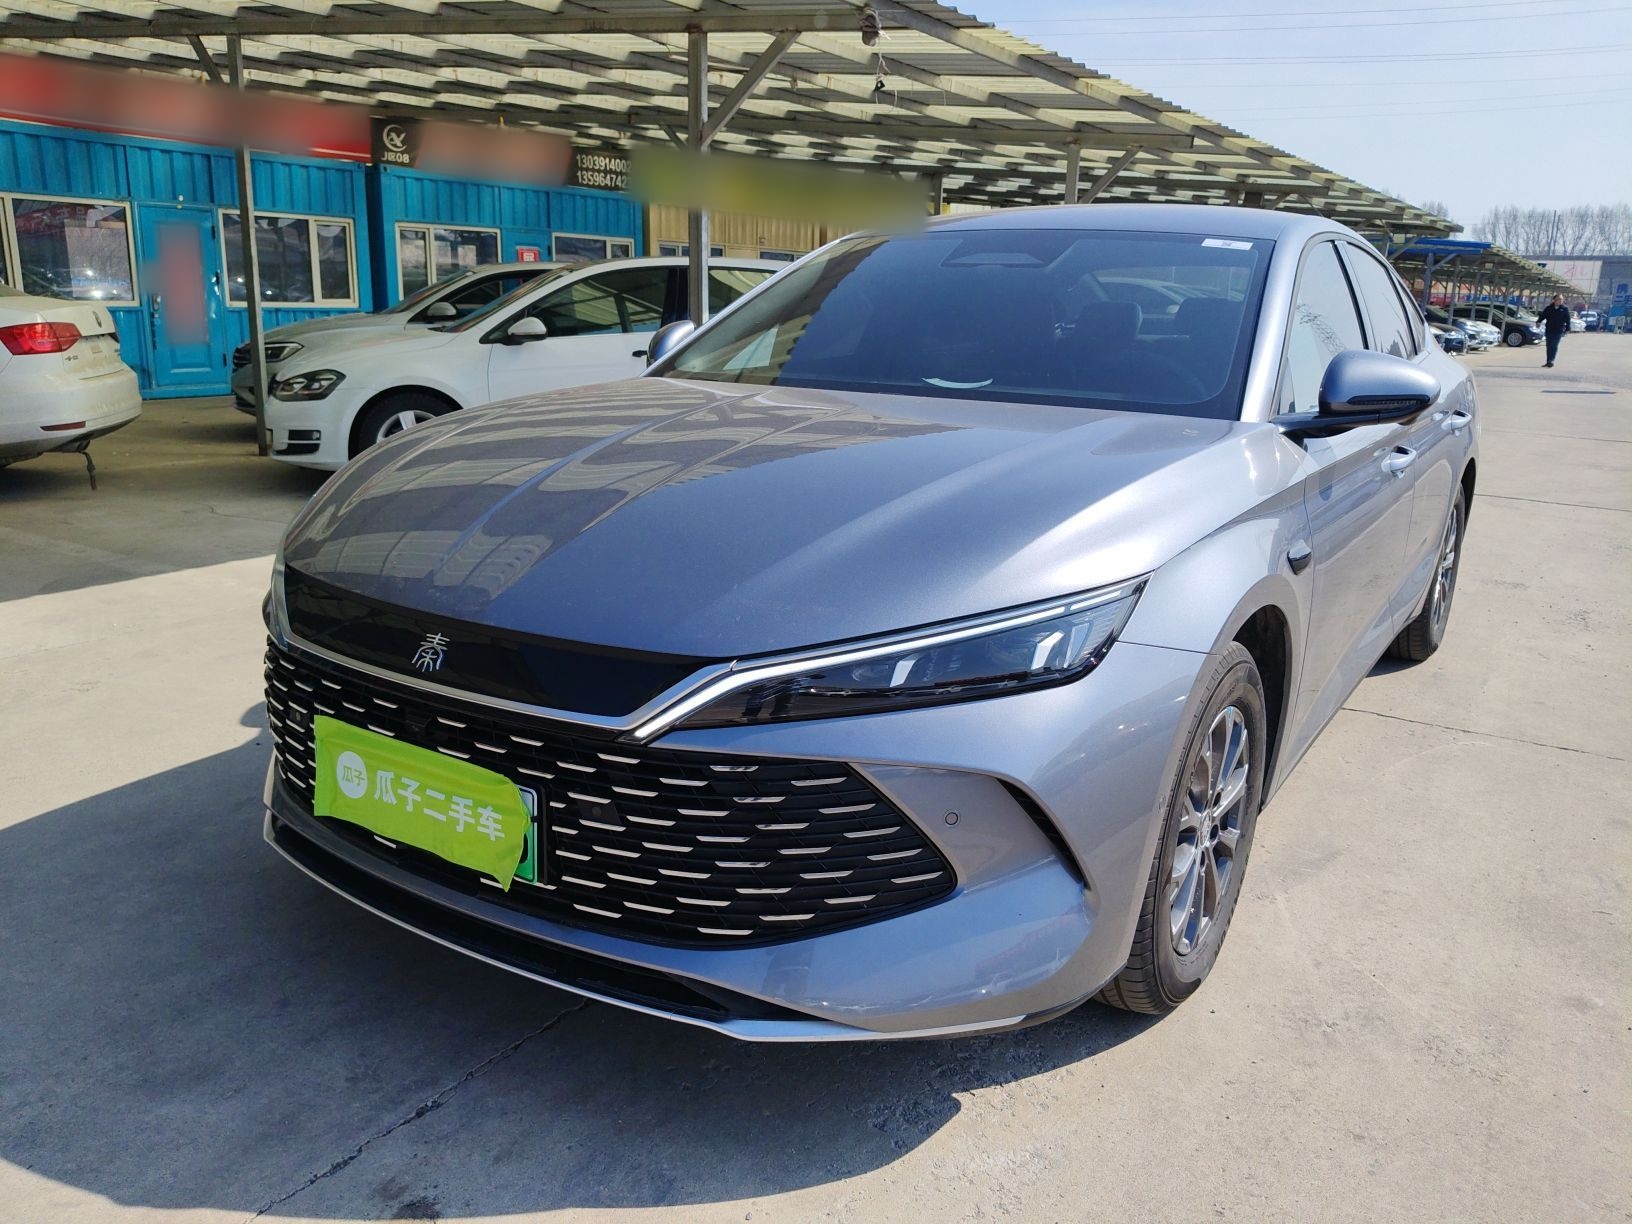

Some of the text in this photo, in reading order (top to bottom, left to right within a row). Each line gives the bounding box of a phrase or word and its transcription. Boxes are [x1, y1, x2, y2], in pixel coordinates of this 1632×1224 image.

[411, 632, 451, 673] 秦
[343, 764, 366, 787] 瓜子
[374, 770, 505, 841] 瓜子二手车
